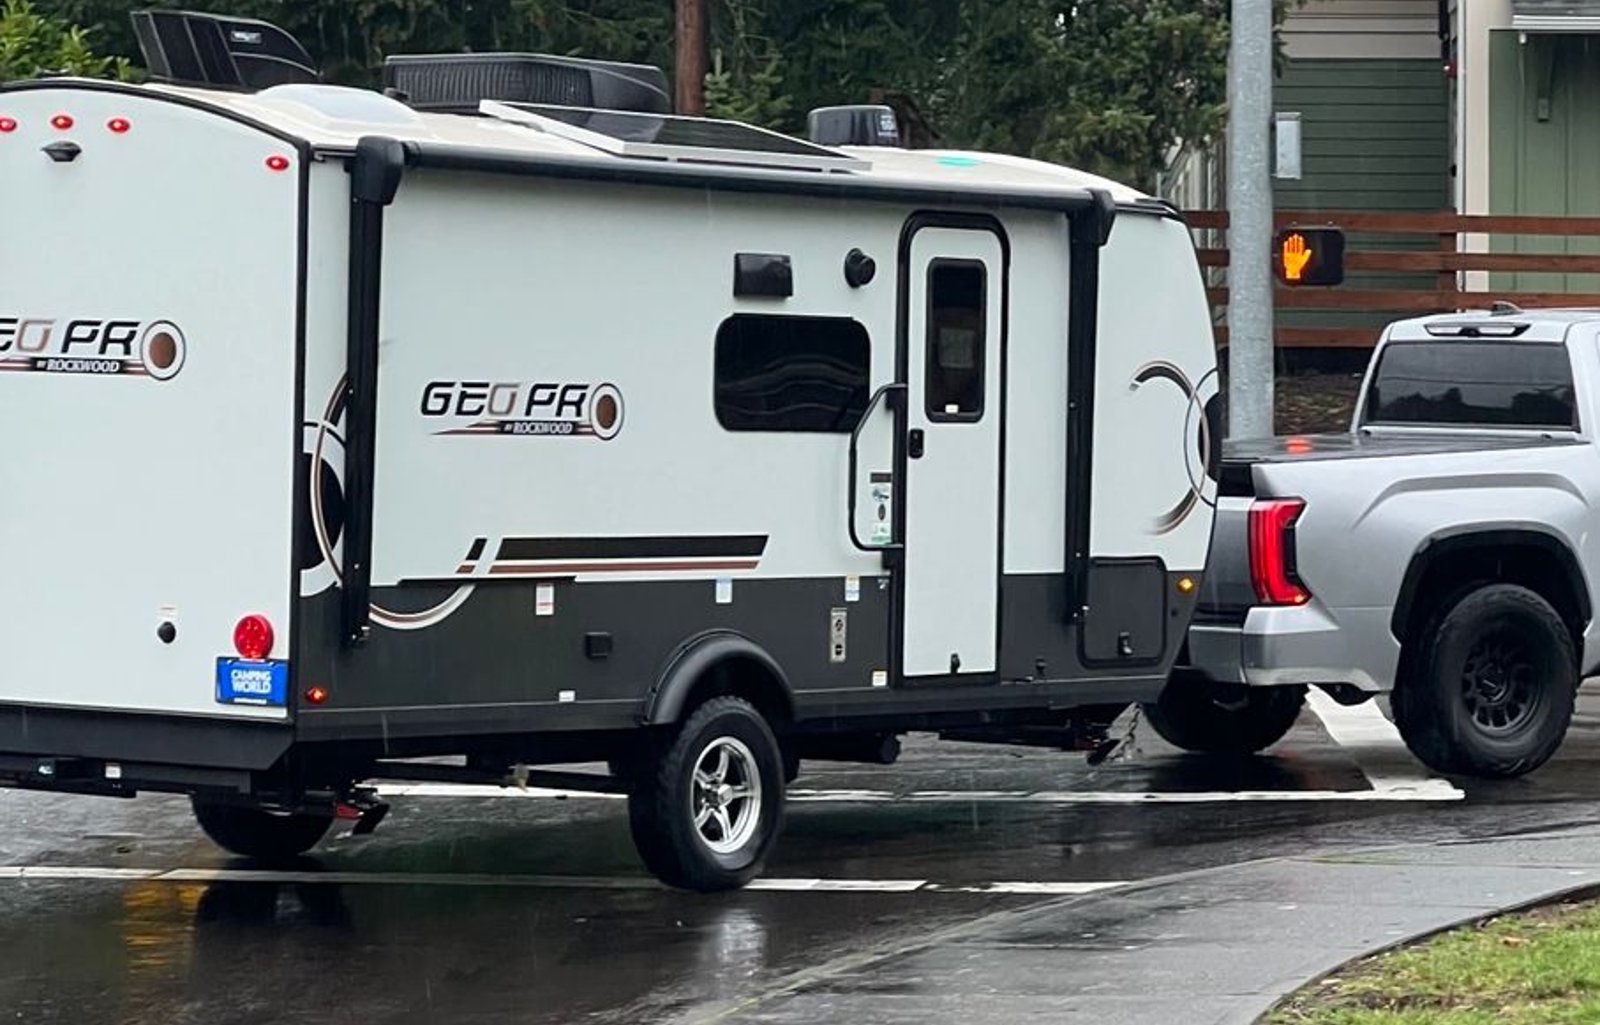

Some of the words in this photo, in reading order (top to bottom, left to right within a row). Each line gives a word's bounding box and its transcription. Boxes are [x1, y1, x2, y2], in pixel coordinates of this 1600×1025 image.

[61, 319, 186, 381] PRO
[47, 359, 120, 373] ROCKWOOD
[421, 382, 521, 416] GEO
[525, 383, 625, 440] PRO
[513, 421, 573, 434] ROCKWOOD
[230, 669, 272, 681] CAMPING
[232, 680, 272, 693] WORLD
